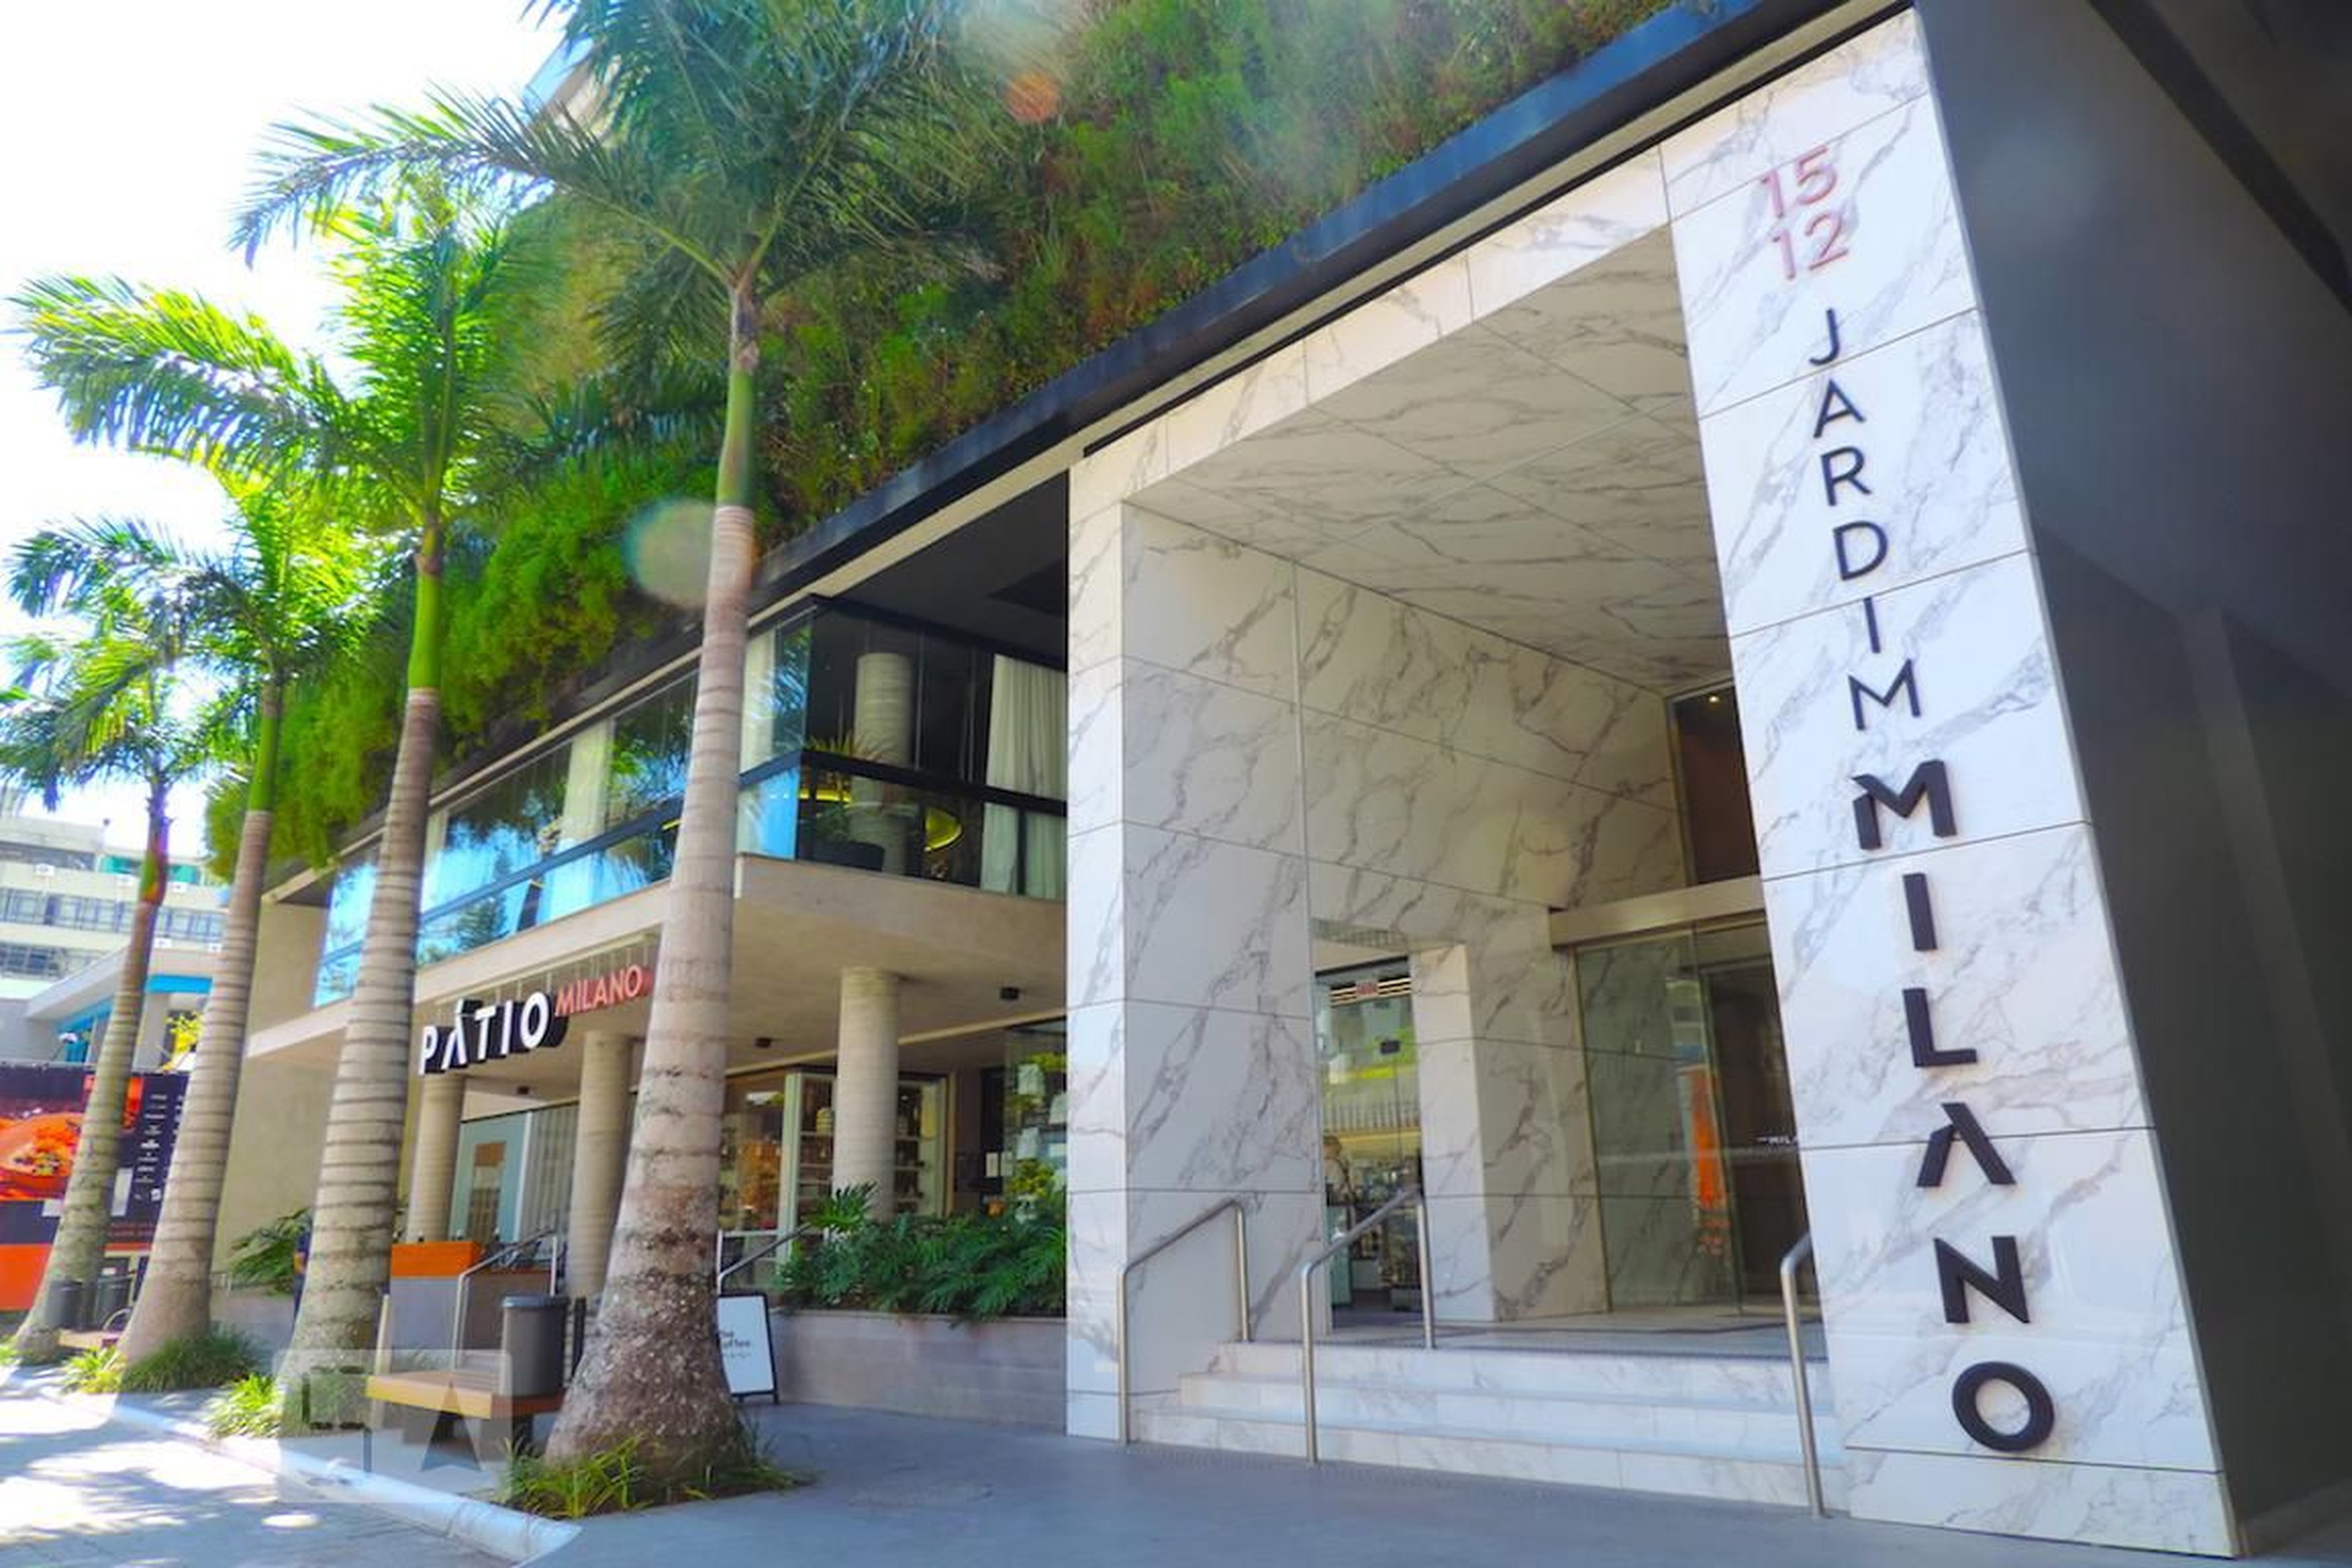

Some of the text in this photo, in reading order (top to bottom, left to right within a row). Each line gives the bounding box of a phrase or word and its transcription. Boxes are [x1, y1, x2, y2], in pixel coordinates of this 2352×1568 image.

[1762, 144, 1837, 218] 15
[1772, 209, 1849, 280] 12
[1809, 308, 2054, 1452] JARDIM MILANO
[418, 964, 644, 1076] PÁTIO MILANO
